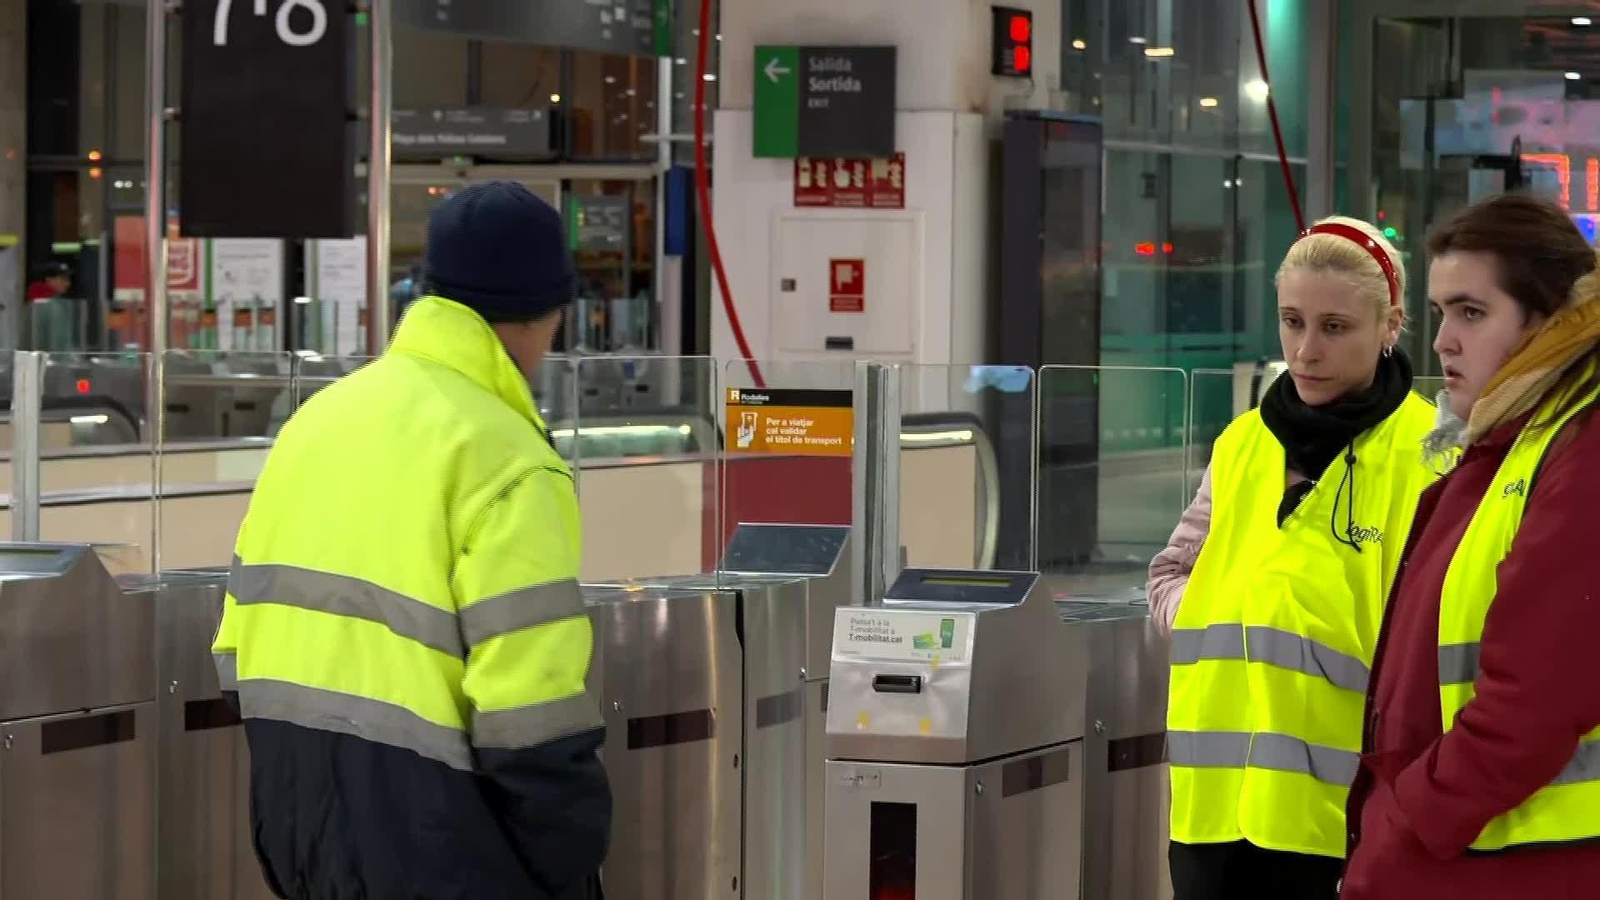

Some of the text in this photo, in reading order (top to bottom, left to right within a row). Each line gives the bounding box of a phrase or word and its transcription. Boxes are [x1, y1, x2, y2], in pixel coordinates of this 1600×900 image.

[808, 56, 853, 72] Salida
[808, 76, 862, 92] Sortida
[731, 389, 740, 400] R
[766, 417, 780, 426] Per
[789, 418, 814, 428] viatjar
[766, 427, 807, 435] cal validar
[765, 436, 774, 444] el
[804, 437, 842, 446] transport
[848, 633, 903, 644] T-mobilitat.cat
